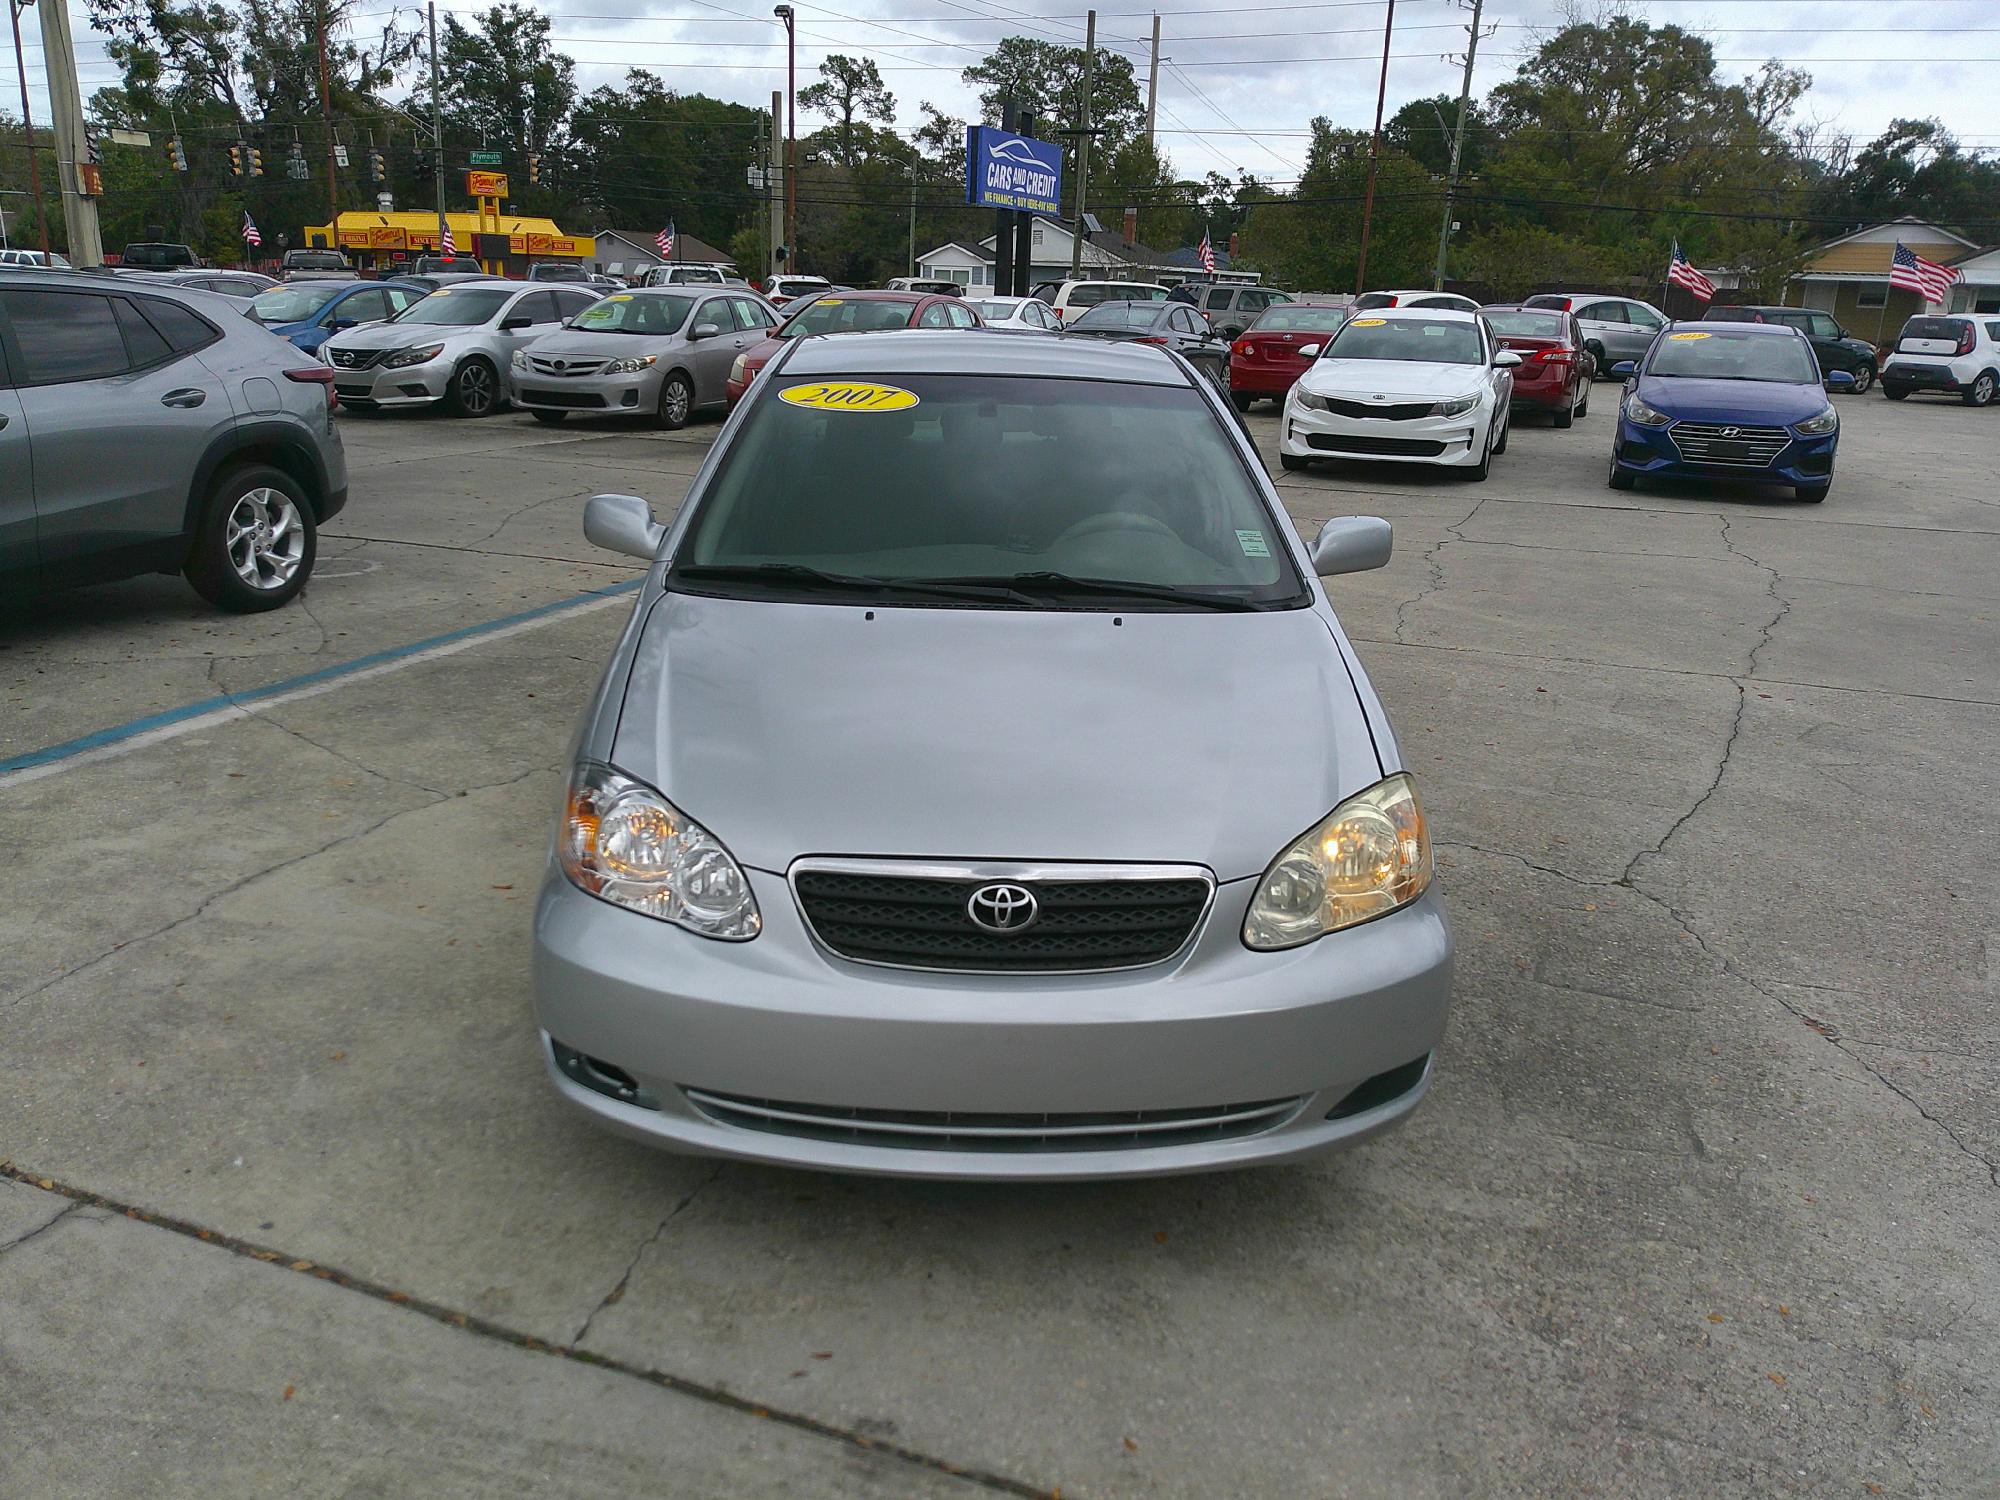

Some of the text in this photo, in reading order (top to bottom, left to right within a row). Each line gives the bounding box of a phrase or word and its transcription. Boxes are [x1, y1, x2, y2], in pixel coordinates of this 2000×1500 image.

[472, 152, 500, 160] Plymouth
[988, 163, 1056, 198] CARS AND CREDIT
[985, 192, 992, 202] WE
[993, 193, 1013, 205] FINANCE
[1018, 197, 1026, 207] BUY
[1047, 203, 1057, 212] HERE
[797, 387, 901, 407] 2007
